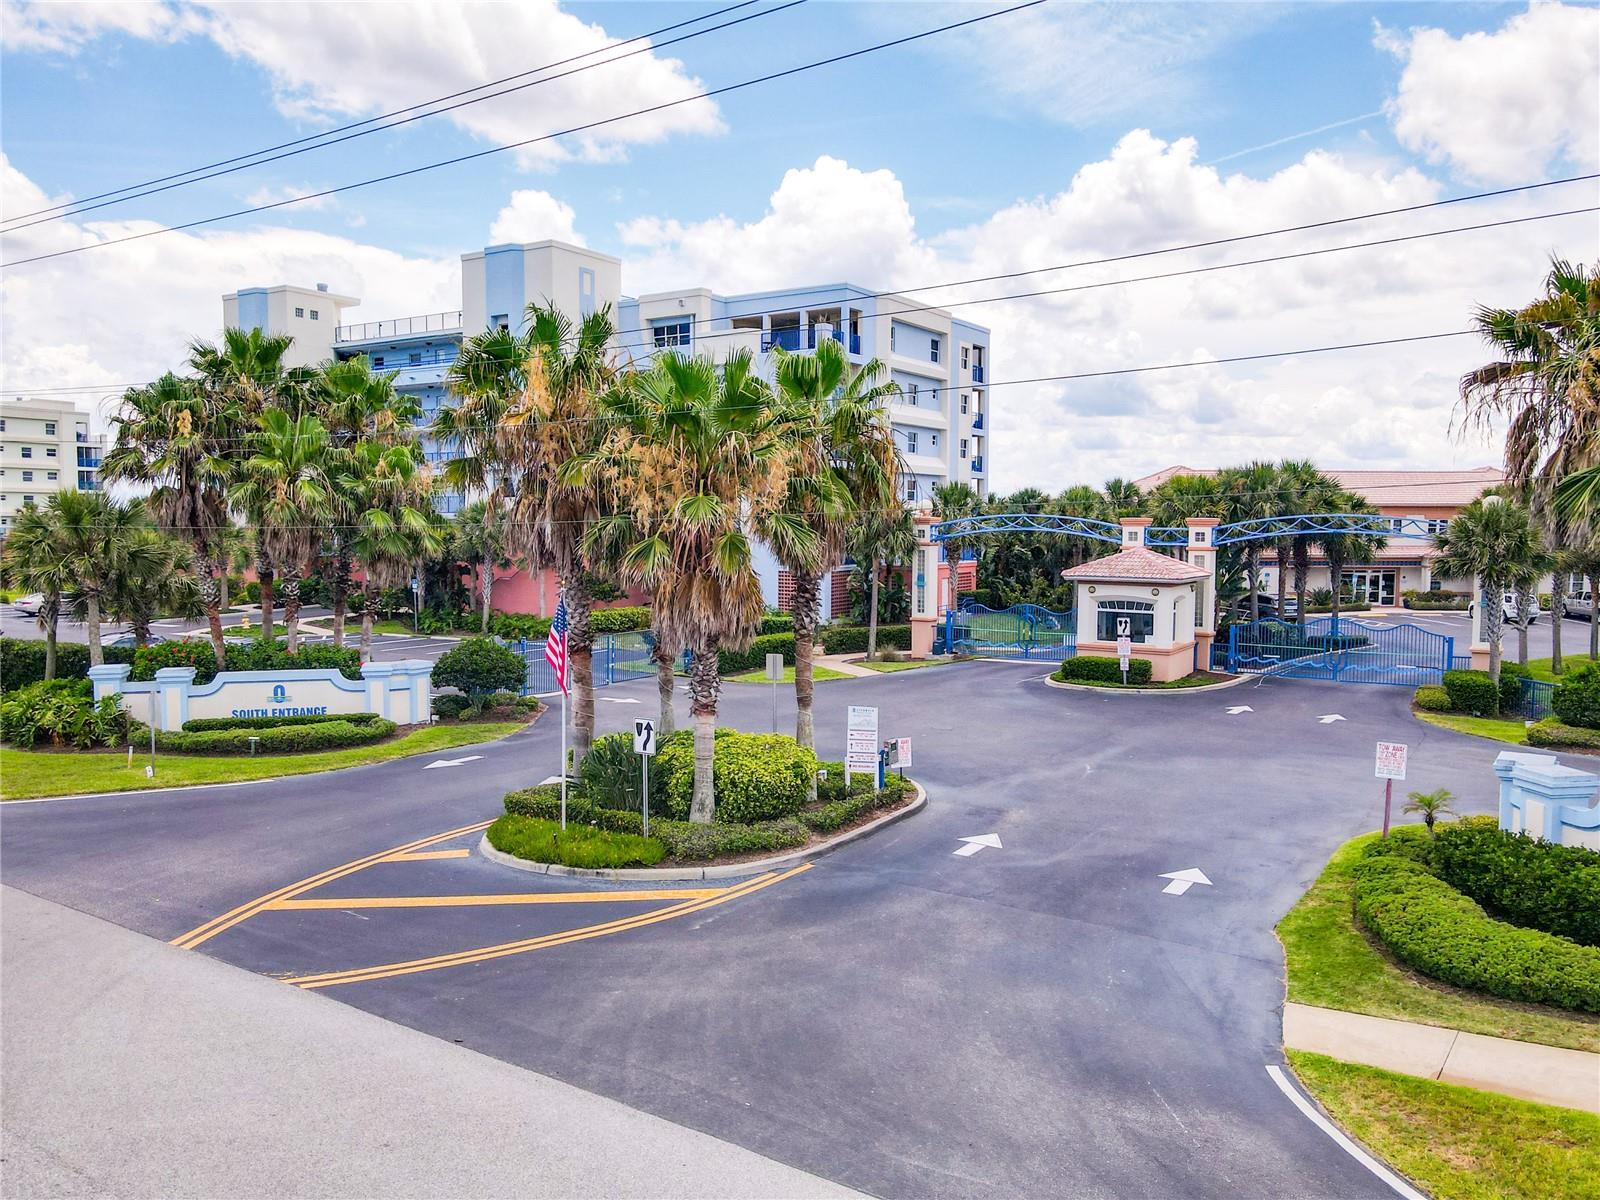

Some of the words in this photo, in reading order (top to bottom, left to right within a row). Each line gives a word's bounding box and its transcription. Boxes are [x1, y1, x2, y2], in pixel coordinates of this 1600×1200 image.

[232, 709, 268, 718] SOUTH
[272, 706, 327, 717] ENTRANCE
[1378, 743, 1390, 751] TOW
[1391, 745, 1405, 753] AWAY
[1384, 751, 1398, 759] ZONE
